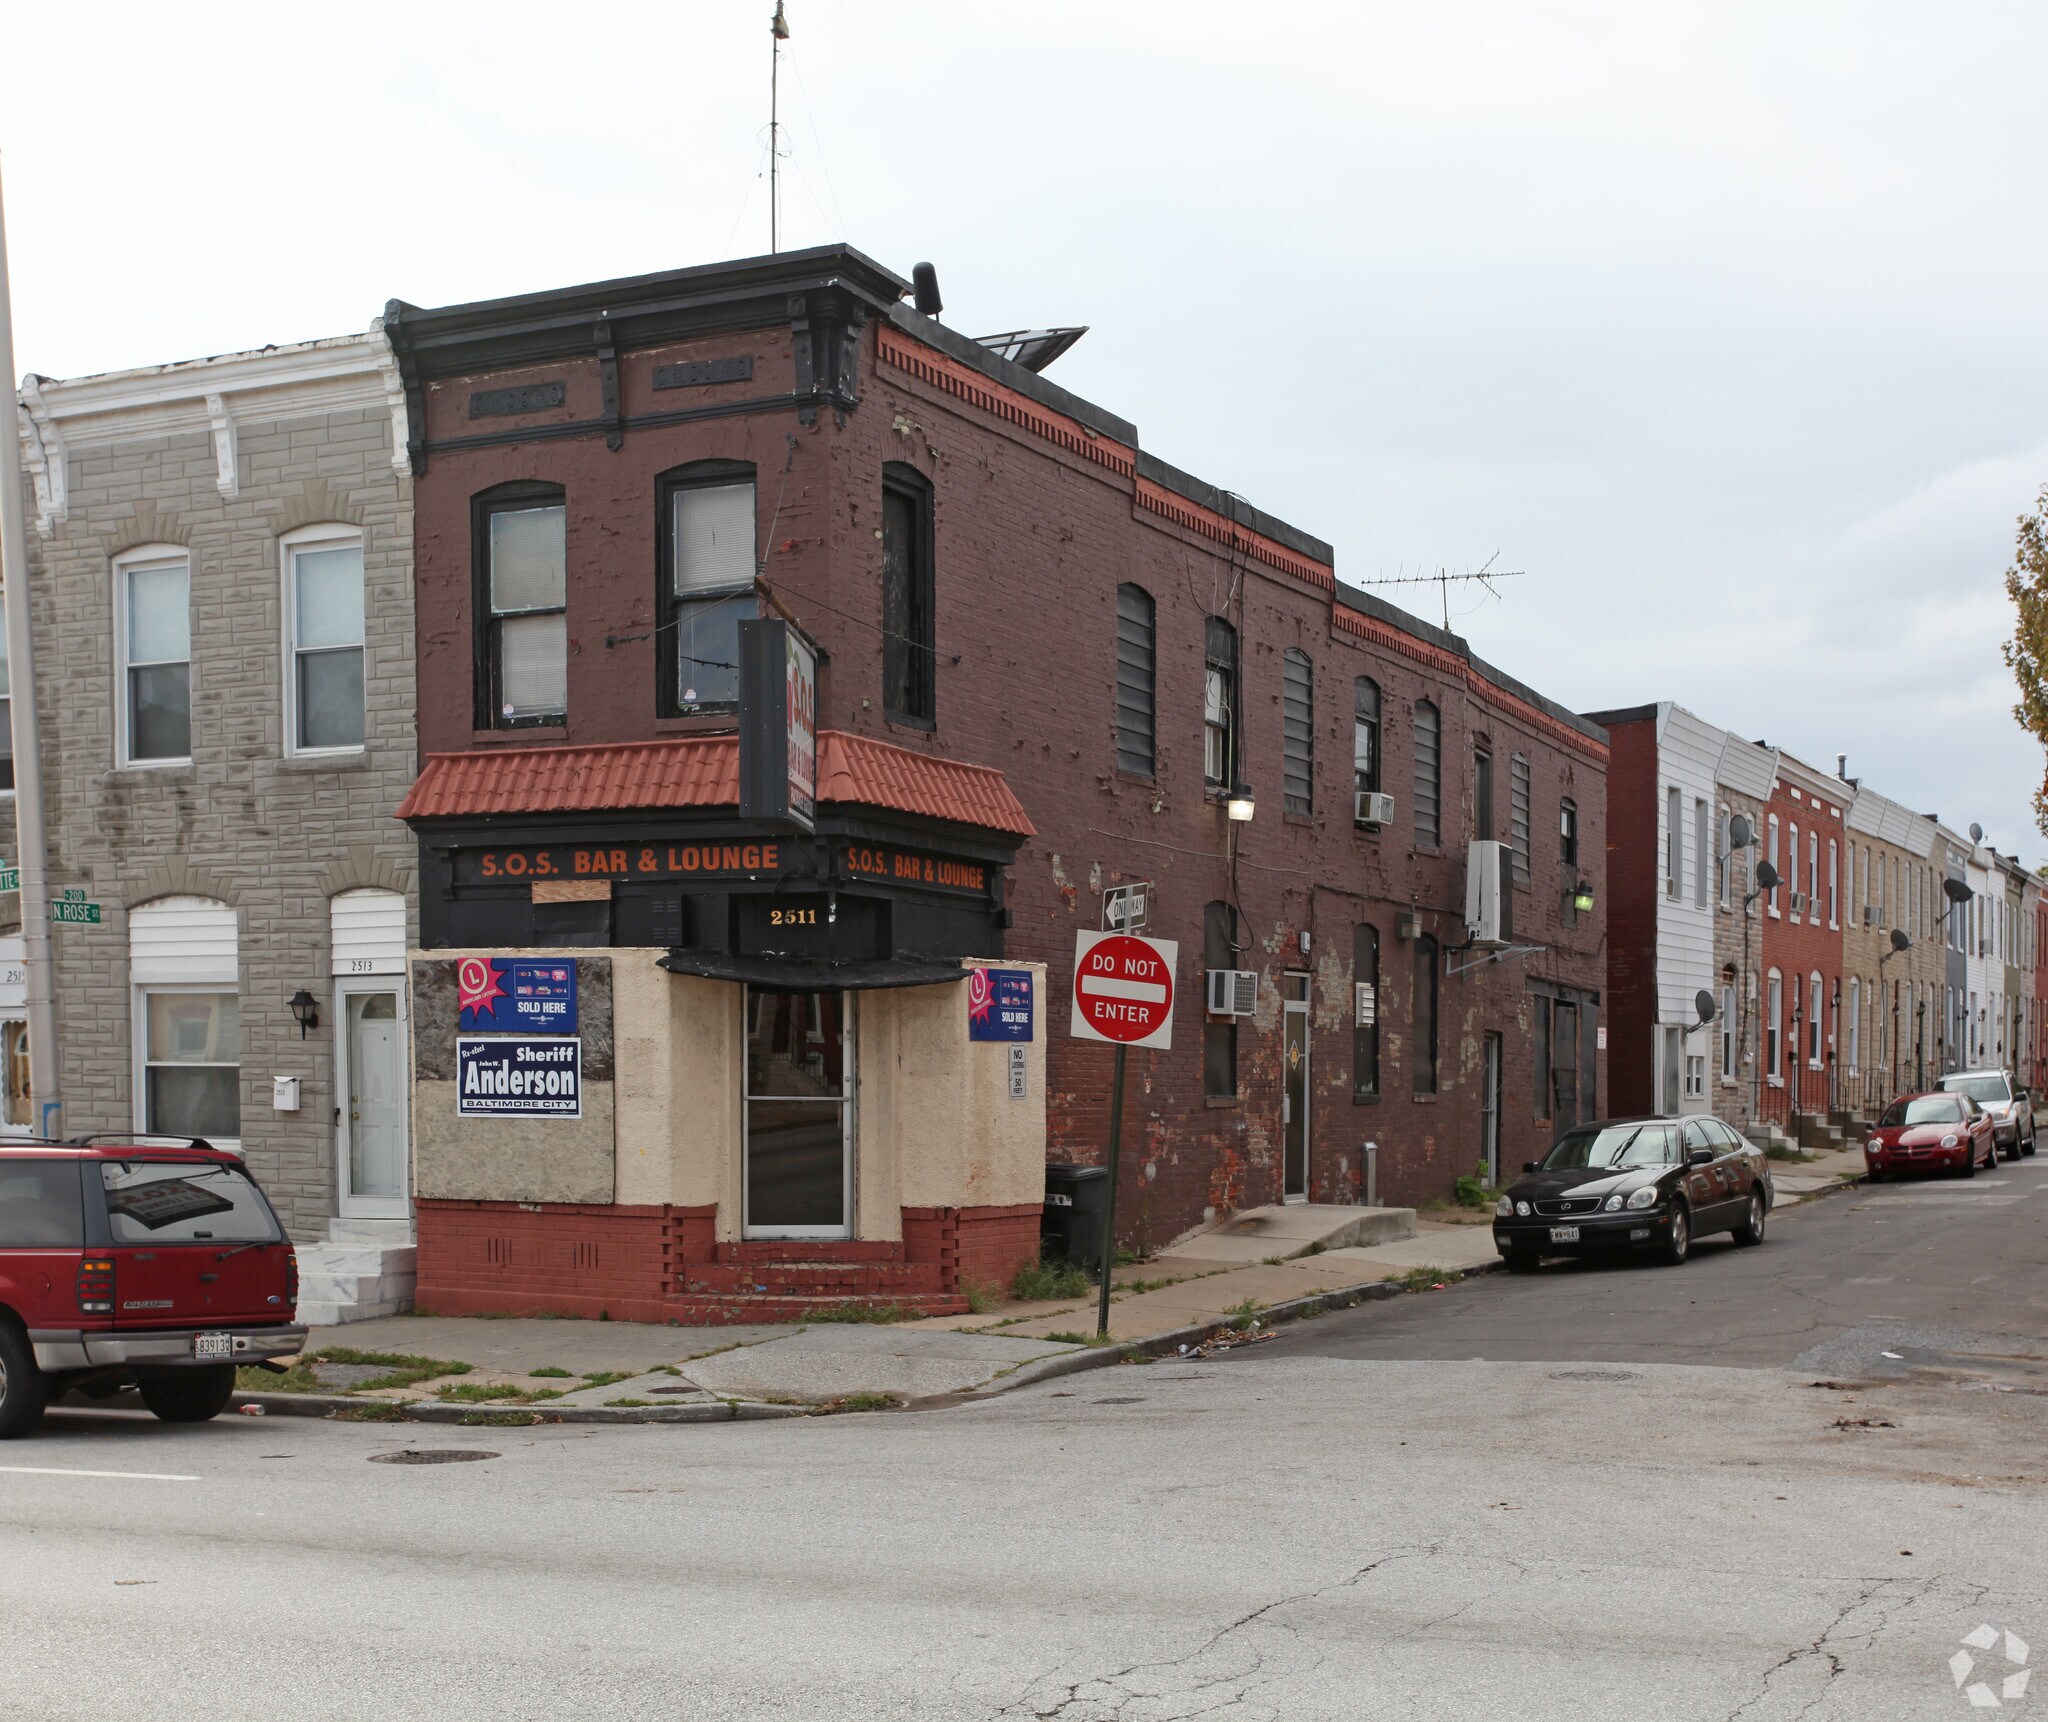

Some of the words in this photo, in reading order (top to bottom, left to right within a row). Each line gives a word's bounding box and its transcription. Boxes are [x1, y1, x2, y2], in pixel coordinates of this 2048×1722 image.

[482, 853, 558, 876] S.O.S.
[575, 850, 627, 873] BAR
[638, 848, 657, 872] &
[668, 845, 778, 871] LOUNGE
[848, 847, 887, 875] S.O.S.
[895, 855, 920, 879] BAR
[924, 859, 934, 882] &
[938, 862, 983, 889] LOUNGE
[69, 891, 83, 901] 200
[63, 905, 91, 921] ROSE
[770, 909, 816, 924] 2511
[352, 960, 373, 971] 2513
[1092, 954, 1115, 972] DO
[1124, 958, 1158, 977] NOT
[517, 1002, 540, 1013] SOLD
[542, 1002, 566, 1013] HERE
[1094, 1001, 1149, 1024] ENTER
[1001, 1011, 1015, 1023] SOLD
[1015, 1012, 1028, 1023] HERE
[516, 1046, 574, 1061] Sheriff
[1013, 1049, 1023, 1060] NO
[464, 1059, 575, 1095] Anderson
[1015, 1078, 1022, 1087] 50
[466, 1100, 539, 1108] BALTIMORE
